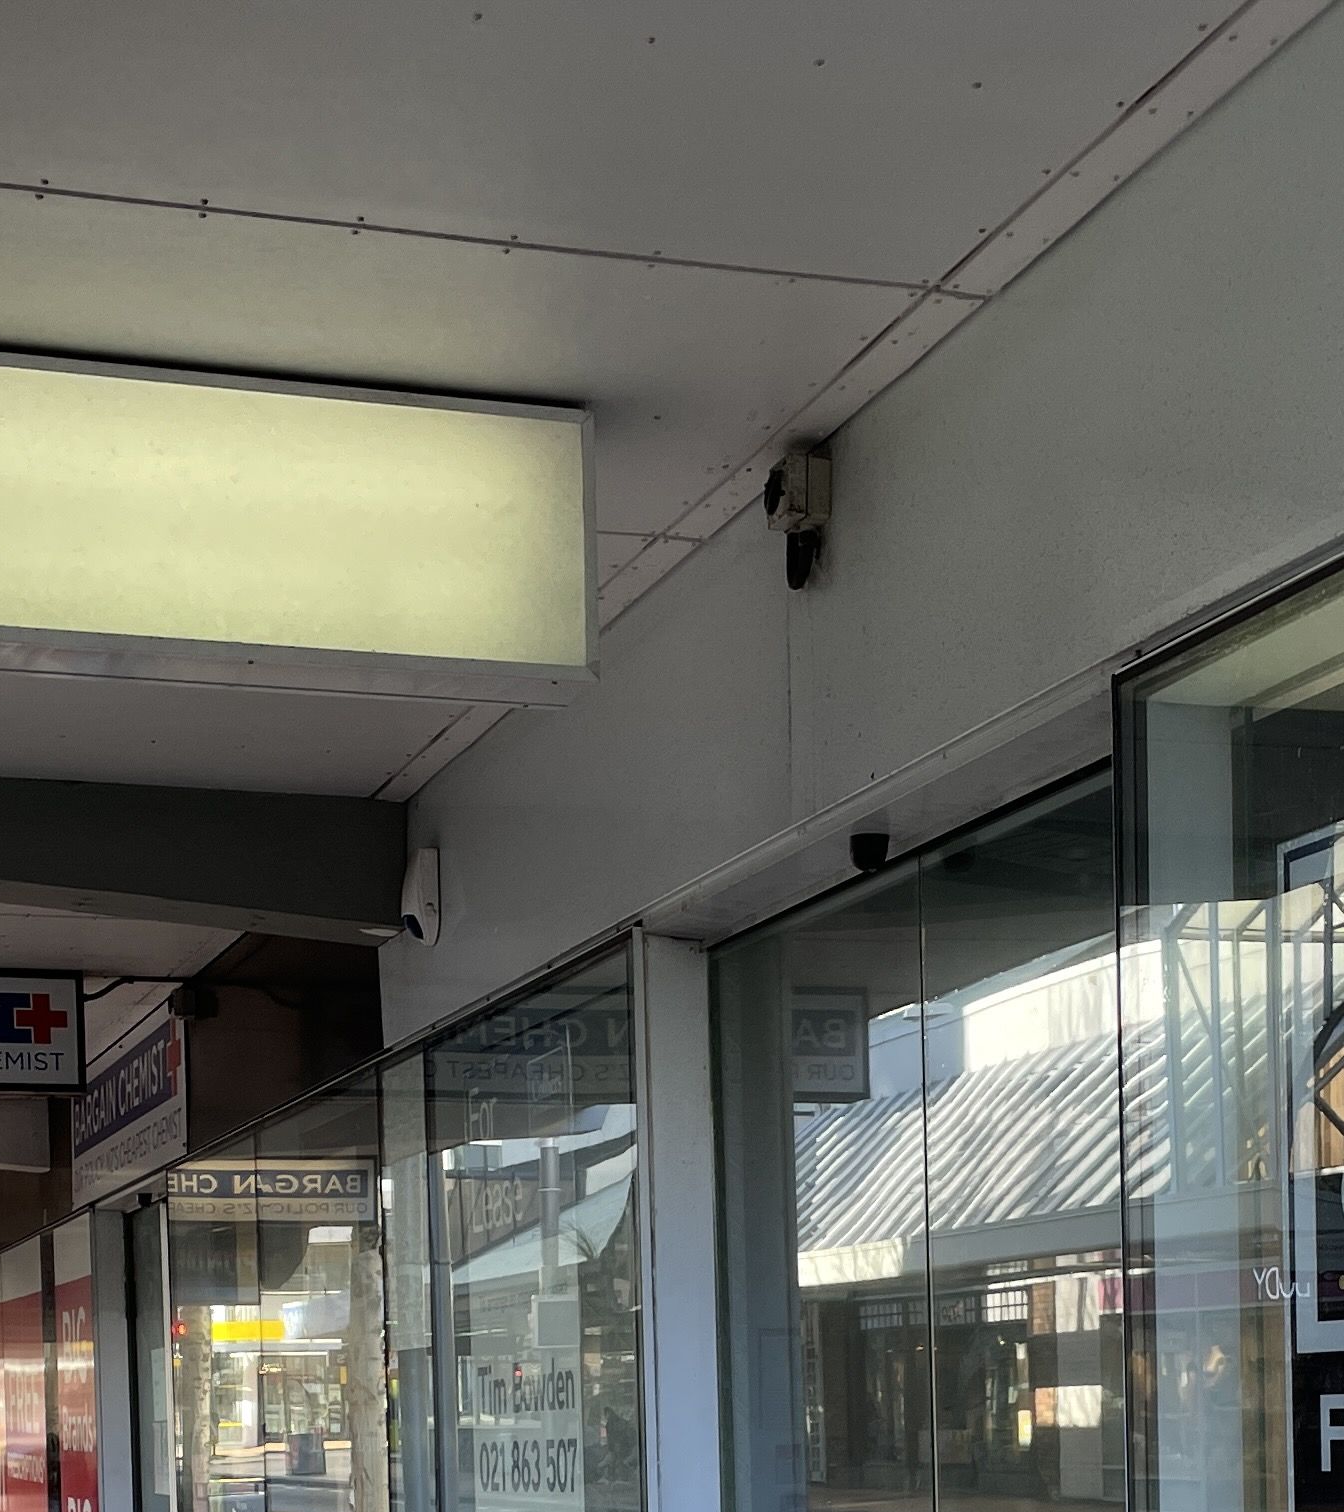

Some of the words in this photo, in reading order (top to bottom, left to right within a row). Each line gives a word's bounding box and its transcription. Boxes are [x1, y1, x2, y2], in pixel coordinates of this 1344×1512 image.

[74, 1074, 117, 1144] BARGAIN
[118, 1038, 166, 1117] CHEMIST
[467, 1087, 498, 1140] For
[470, 1175, 524, 1233] Lease
[62, 1306, 88, 1384] BIG
[477, 1364, 507, 1416] Tim
[512, 1357, 576, 1414] Bowden
[62, 1405, 96, 1453] Brands
[479, 1441, 506, 1493] 021
[511, 1438, 541, 1493] 863
[546, 1437, 578, 1493] 507
